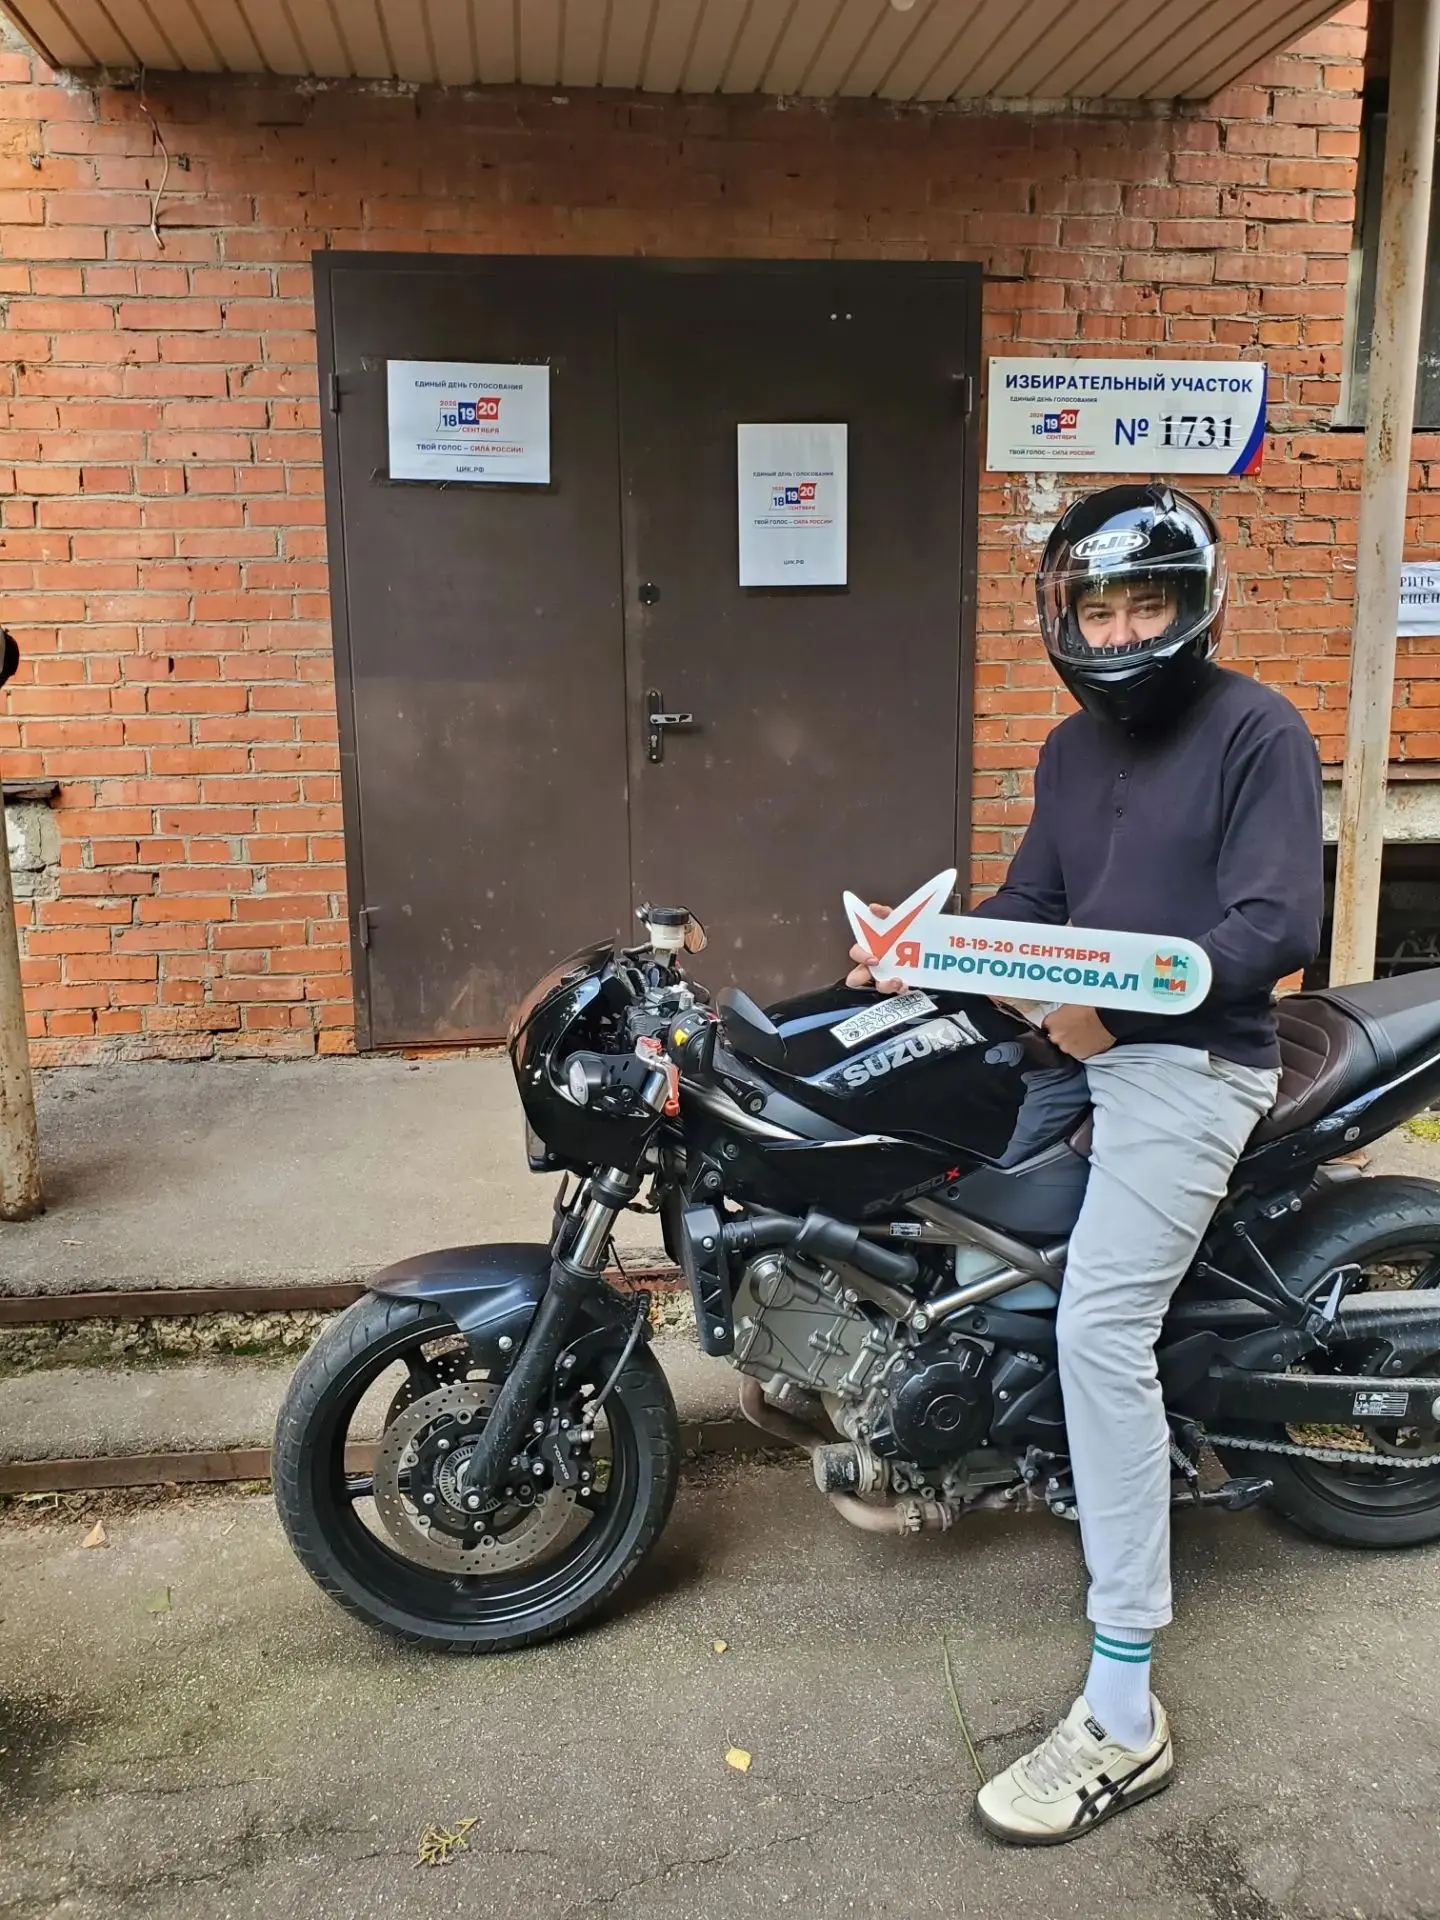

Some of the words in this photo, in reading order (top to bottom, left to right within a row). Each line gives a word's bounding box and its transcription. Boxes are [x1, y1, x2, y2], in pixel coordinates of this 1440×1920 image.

[415, 380, 447, 388] ЕДИНЫЙ
[469, 382, 523, 390] ГОЛОСОВАНИЯ
[1005, 373, 1165, 391] ИЗБИРАТЕЛЬНЫЙ
[1171, 378, 1253, 393] УЧАСТОК
[442, 414, 457, 427] 18
[460, 407, 475, 421] 19
[478, 402, 497, 416] 20
[1031, 424, 1043, 435] 18
[1045, 418, 1058, 430] 19
[1060, 413, 1076, 425] 20
[1160, 415, 1234, 447] 1731
[416, 443, 436, 451] ТВОЙ
[492, 446, 524, 454] РОССИИ!
[773, 496, 784, 507] 18
[786, 491, 798, 502] 19
[800, 486, 814, 497] 20
[1081, 535, 1138, 555] HJC
[1400, 576, 1434, 587] РИТЬ
[948, 935, 1014, 953] 18-19-20
[1018, 943, 1111, 963] СЕНТЯБРЯ
[894, 941, 921, 968] Я
[923, 953, 1139, 991] ПРОГОЛОСОВАЛ
[843, 1010, 988, 1087] SUZUKI
[553, 1443, 570, 1480] TOKICO
